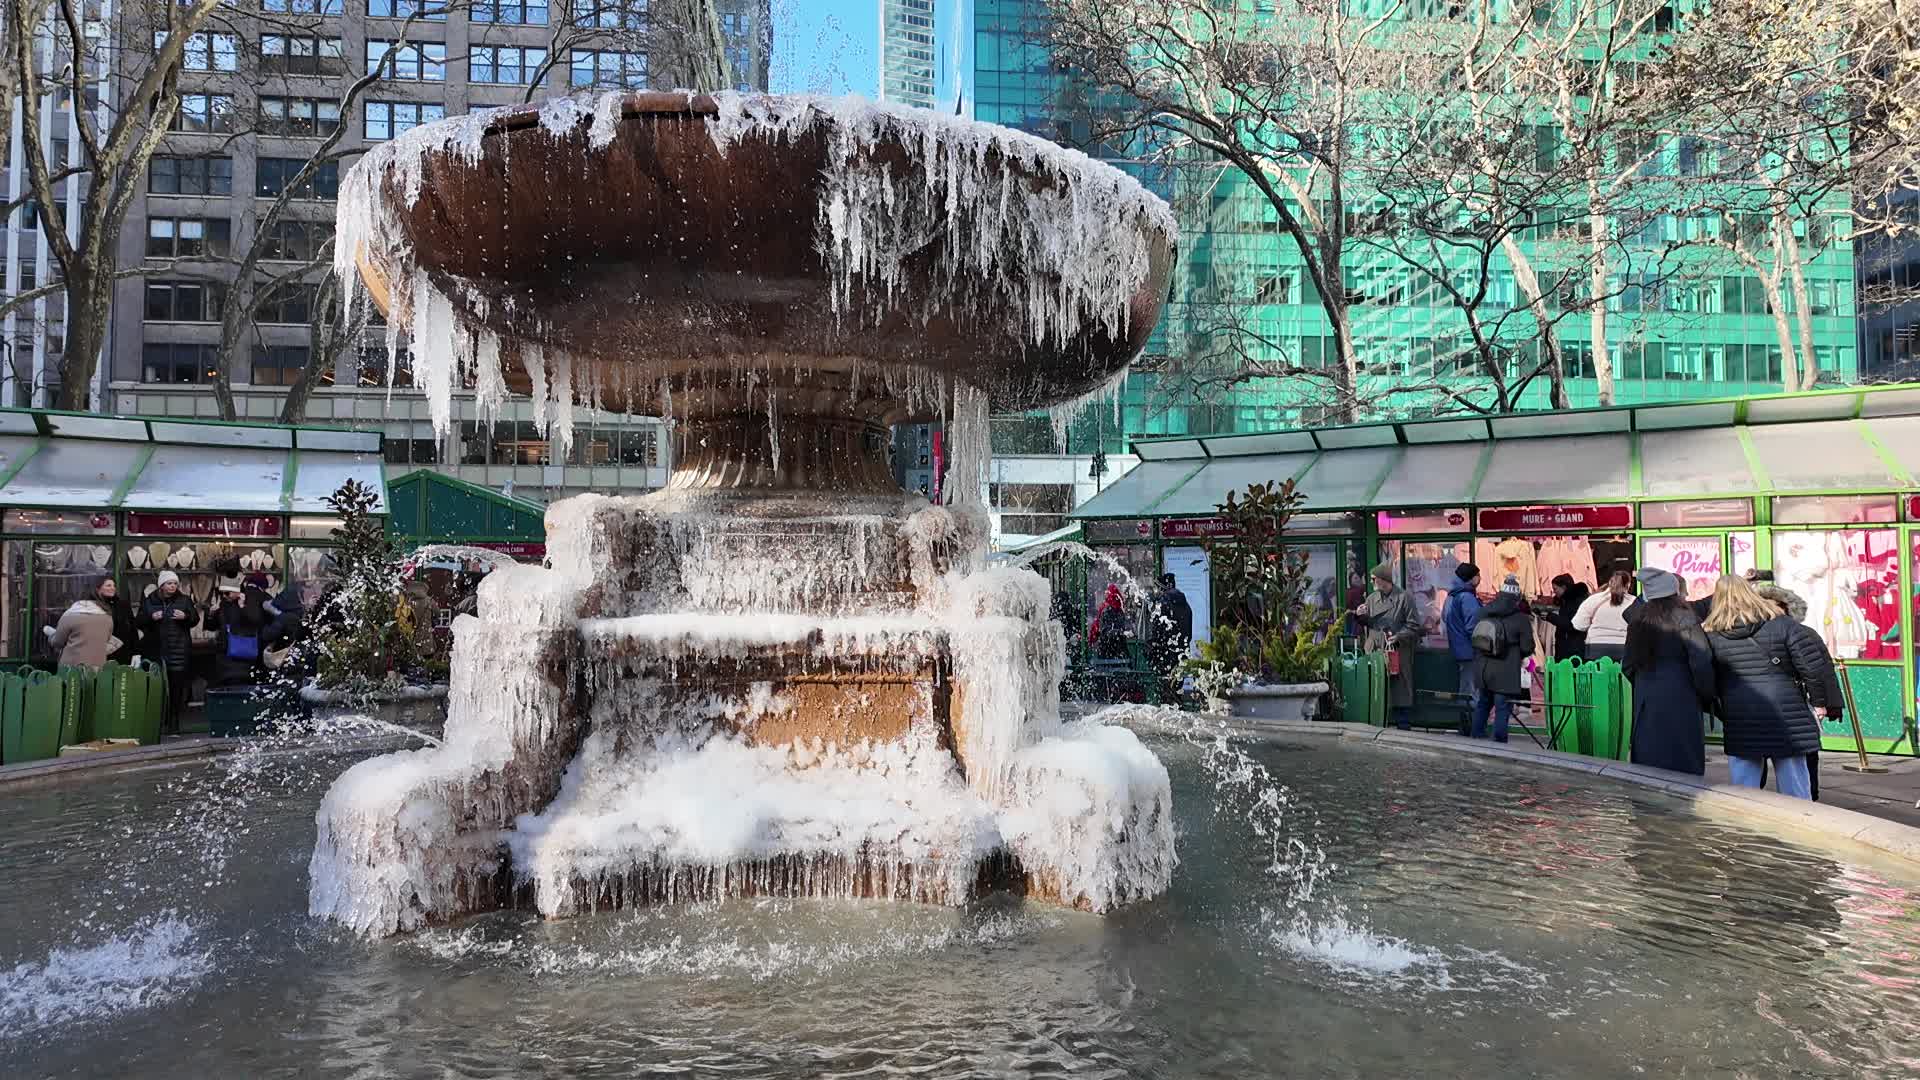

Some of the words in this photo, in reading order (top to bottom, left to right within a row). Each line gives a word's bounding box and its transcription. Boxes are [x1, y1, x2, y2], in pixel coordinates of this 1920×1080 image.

[1522, 514, 1545, 523] MURE
[1554, 513, 1584, 522] GRAND
[1672, 550, 1720, 577] Pink
